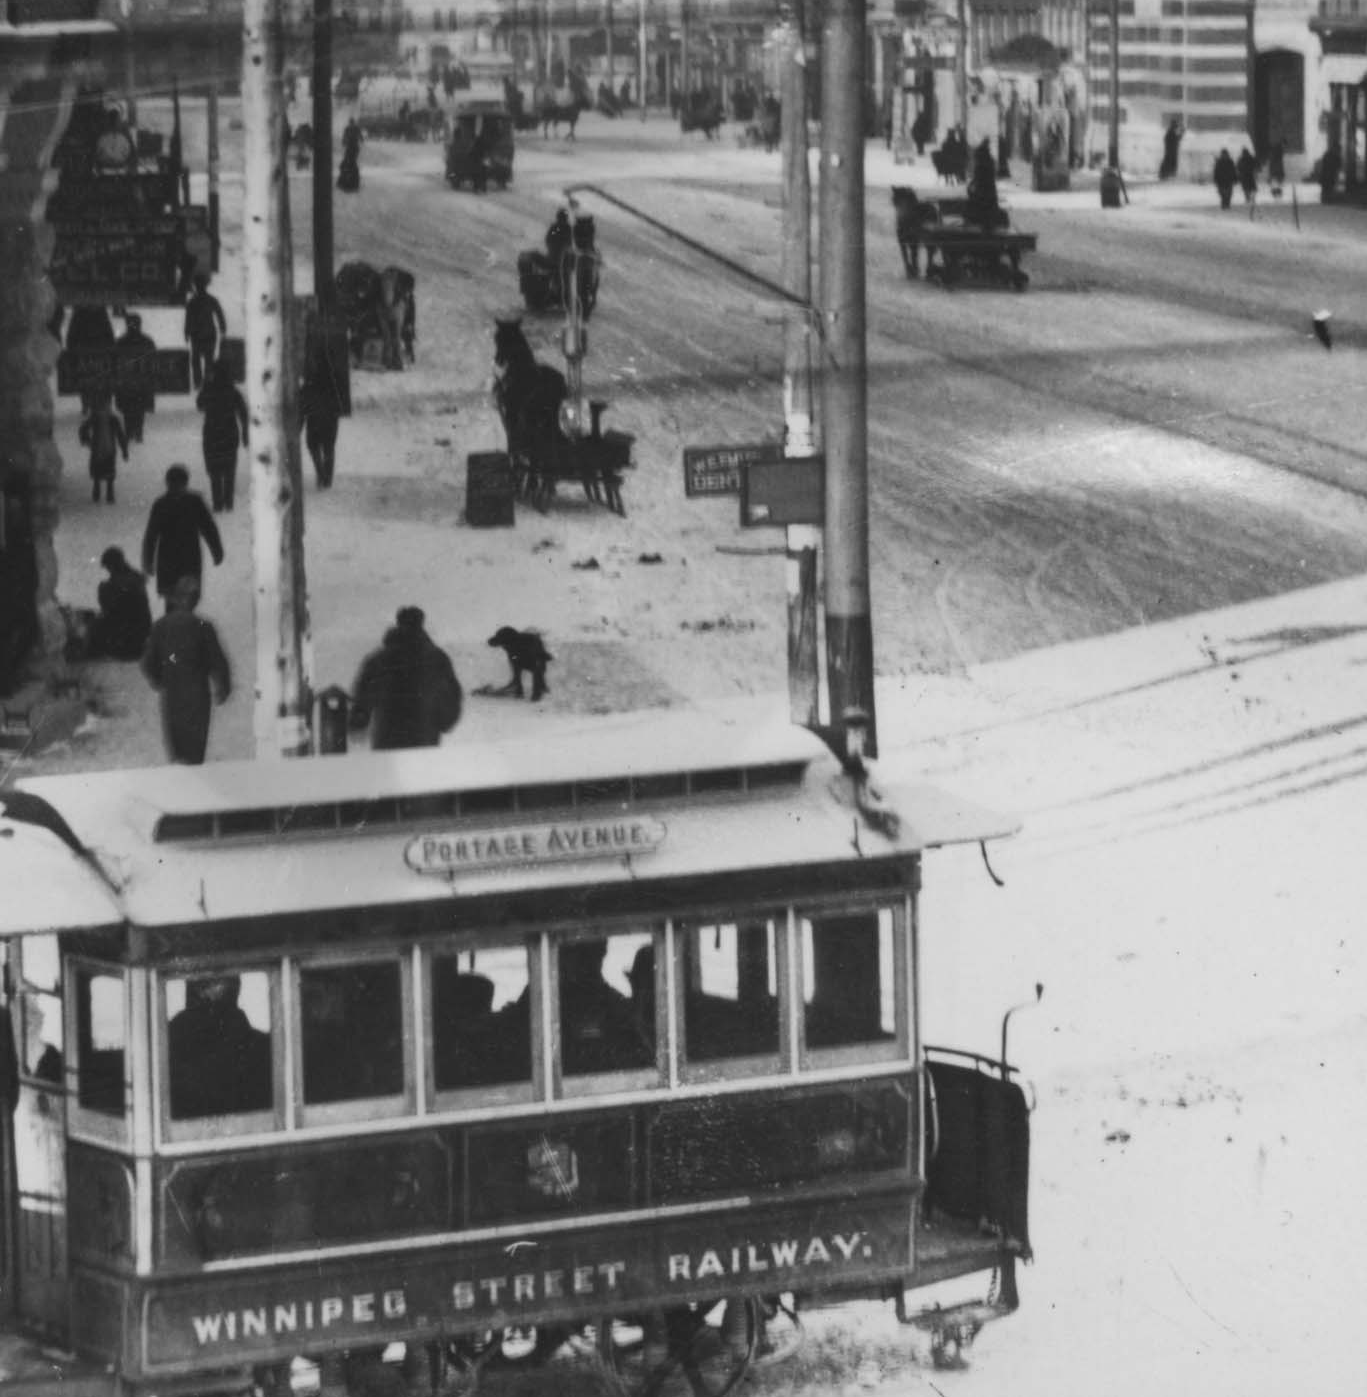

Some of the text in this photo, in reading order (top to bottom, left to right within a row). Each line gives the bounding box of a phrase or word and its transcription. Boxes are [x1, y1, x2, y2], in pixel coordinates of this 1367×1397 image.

[422, 832, 535, 863] PORTAGE
[192, 1231, 873, 1345] WINNIPEG STREET RAILWAY.
